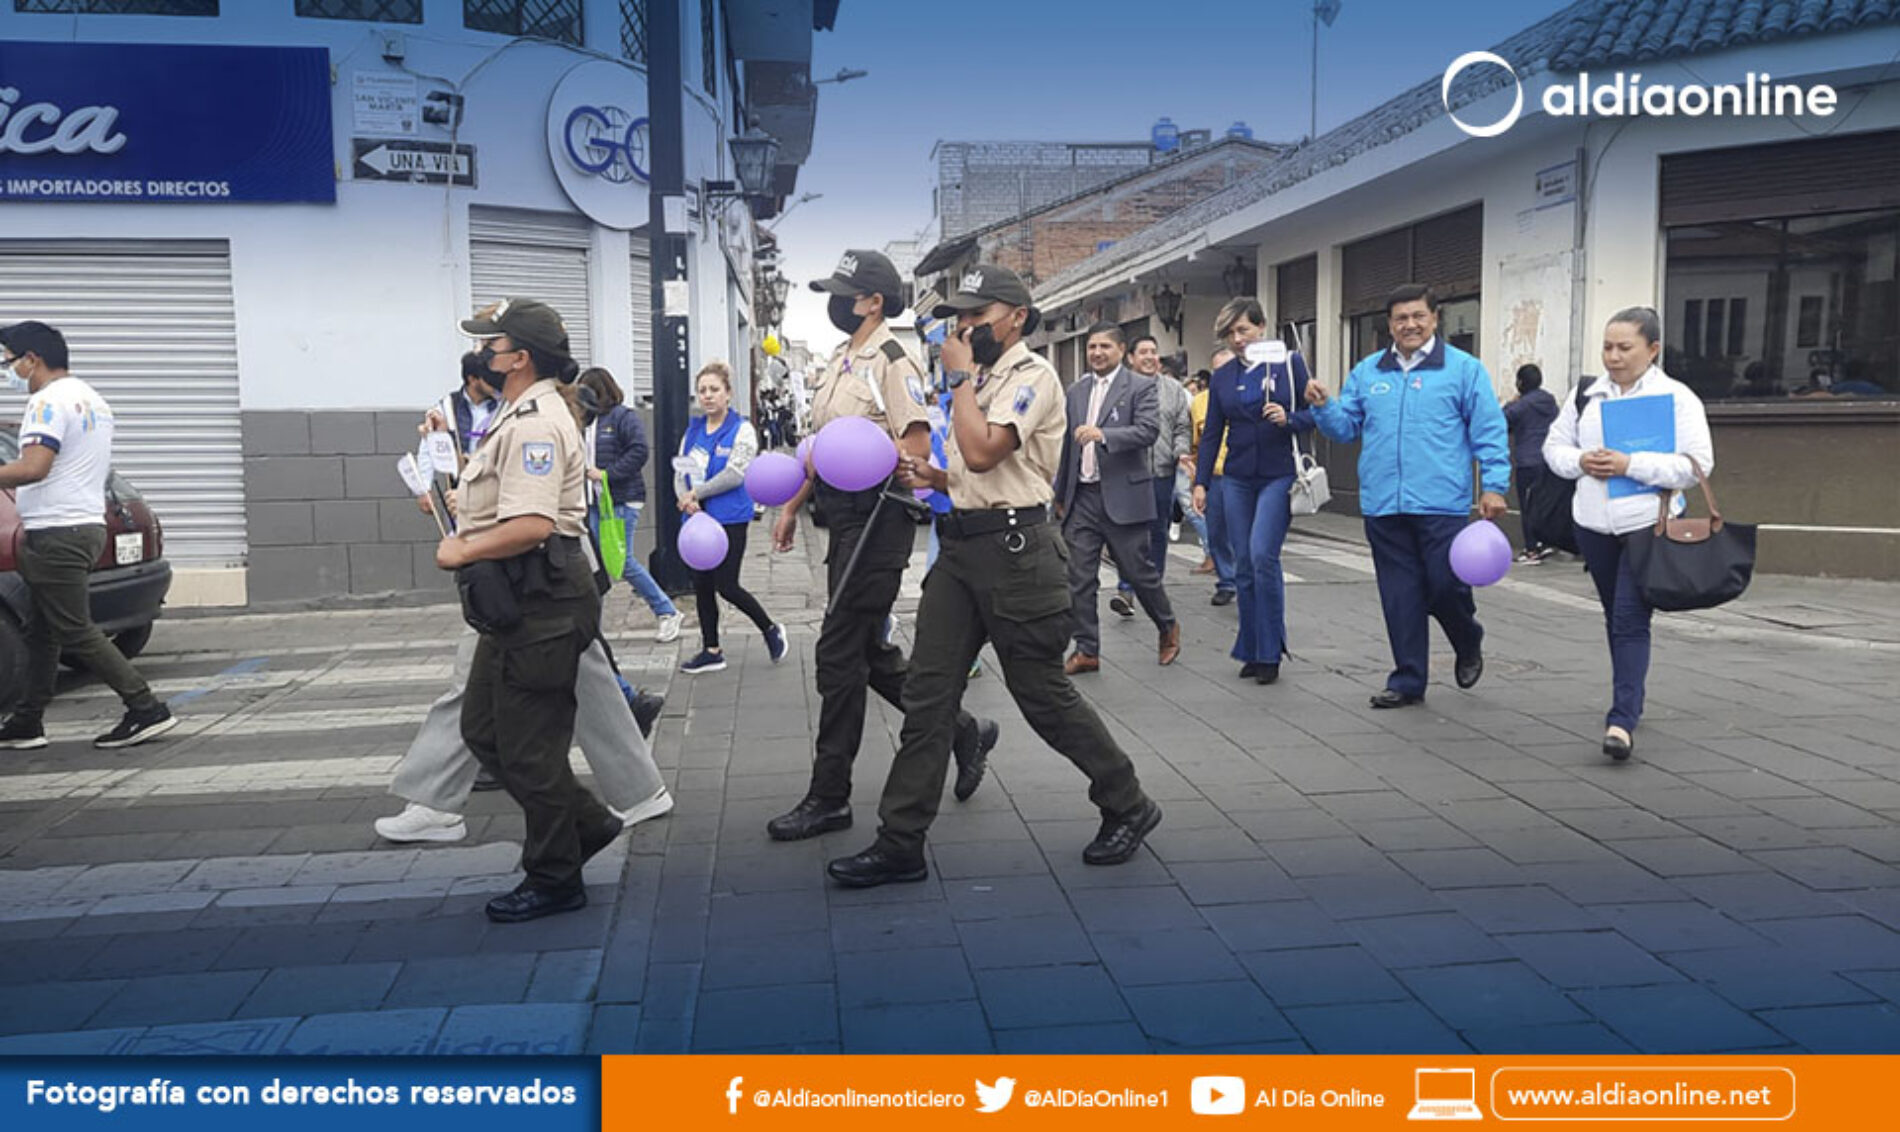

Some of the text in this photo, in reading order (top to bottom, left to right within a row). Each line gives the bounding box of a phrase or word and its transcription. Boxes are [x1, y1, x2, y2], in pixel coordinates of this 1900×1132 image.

[389, 152, 425, 169] UNA
[7, 178, 143, 197] IMPORTADORES
[147, 180, 230, 197] DIRECTOS
